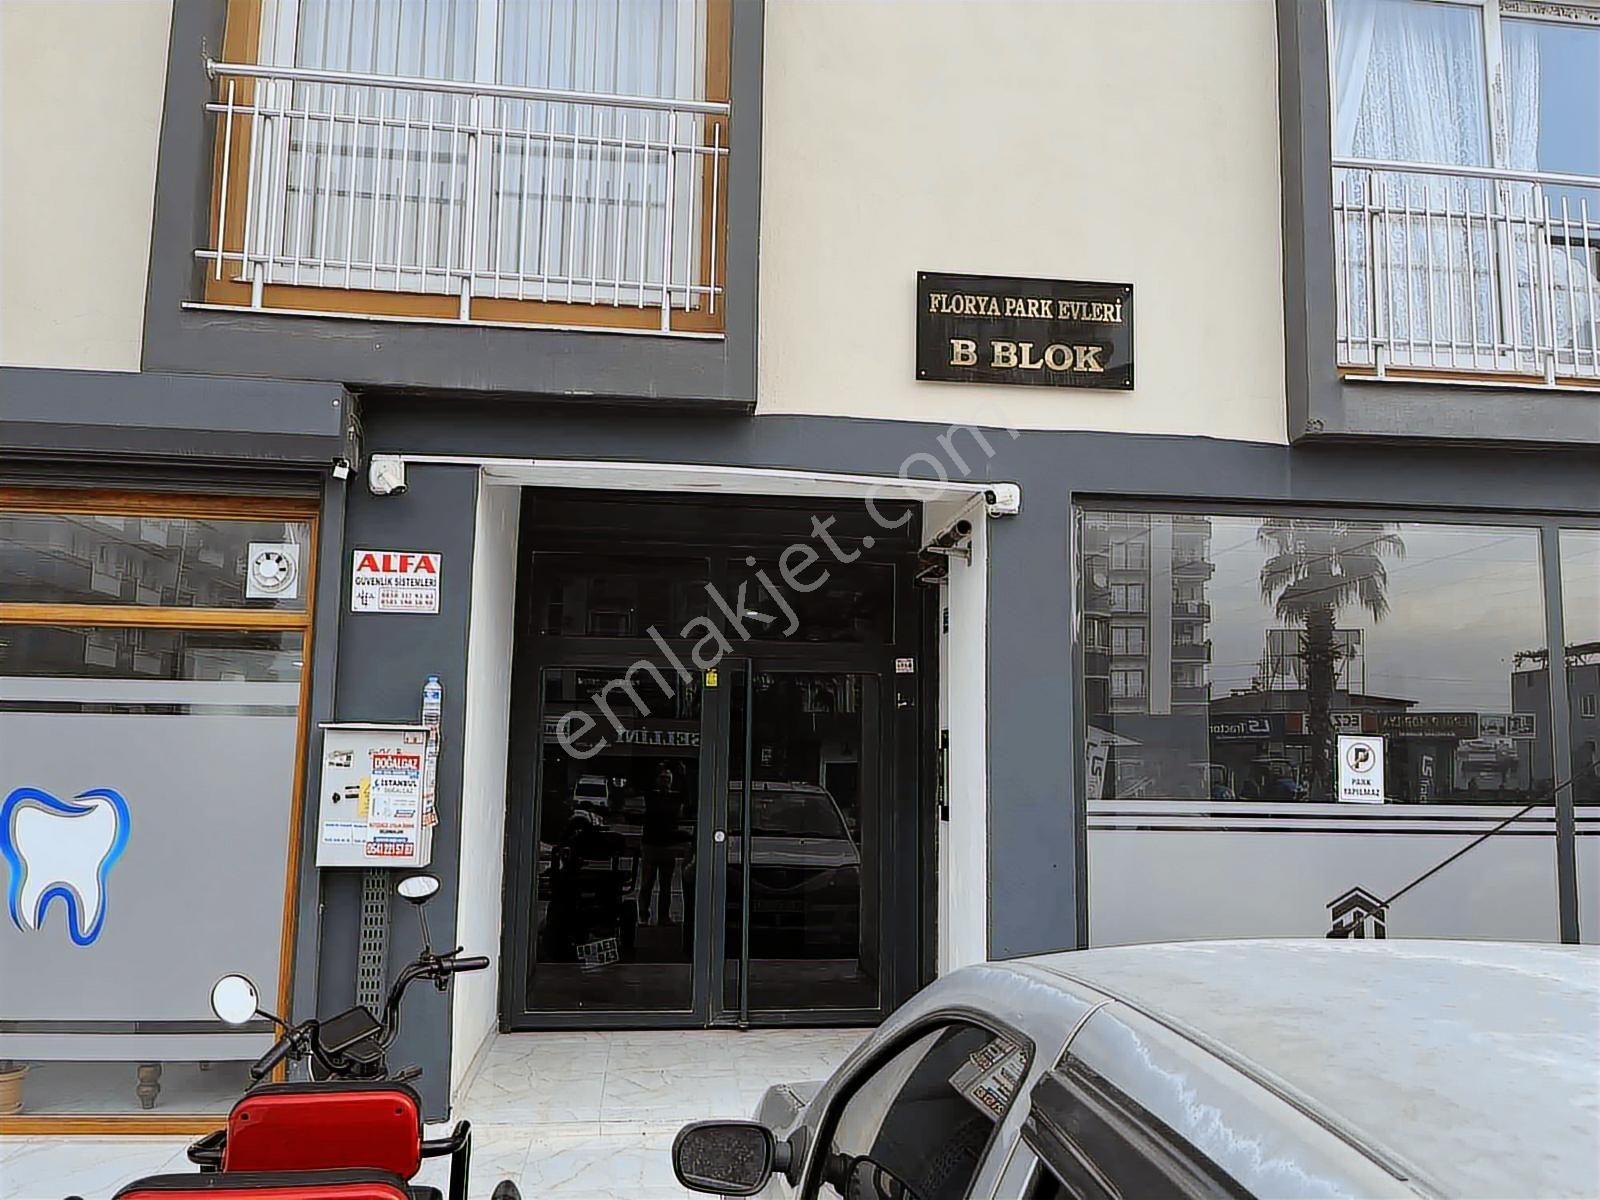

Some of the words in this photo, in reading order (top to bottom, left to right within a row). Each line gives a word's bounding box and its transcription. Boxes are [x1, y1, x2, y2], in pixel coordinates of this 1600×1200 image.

[929, 293, 1001, 317] FLORYA
[1004, 297, 1053, 320] PARK
[1057, 298, 1123, 323] EVLERİ
[950, 338, 978, 366] B
[991, 340, 1104, 373] BLOK
[356, 553, 437, 574] ALFA
